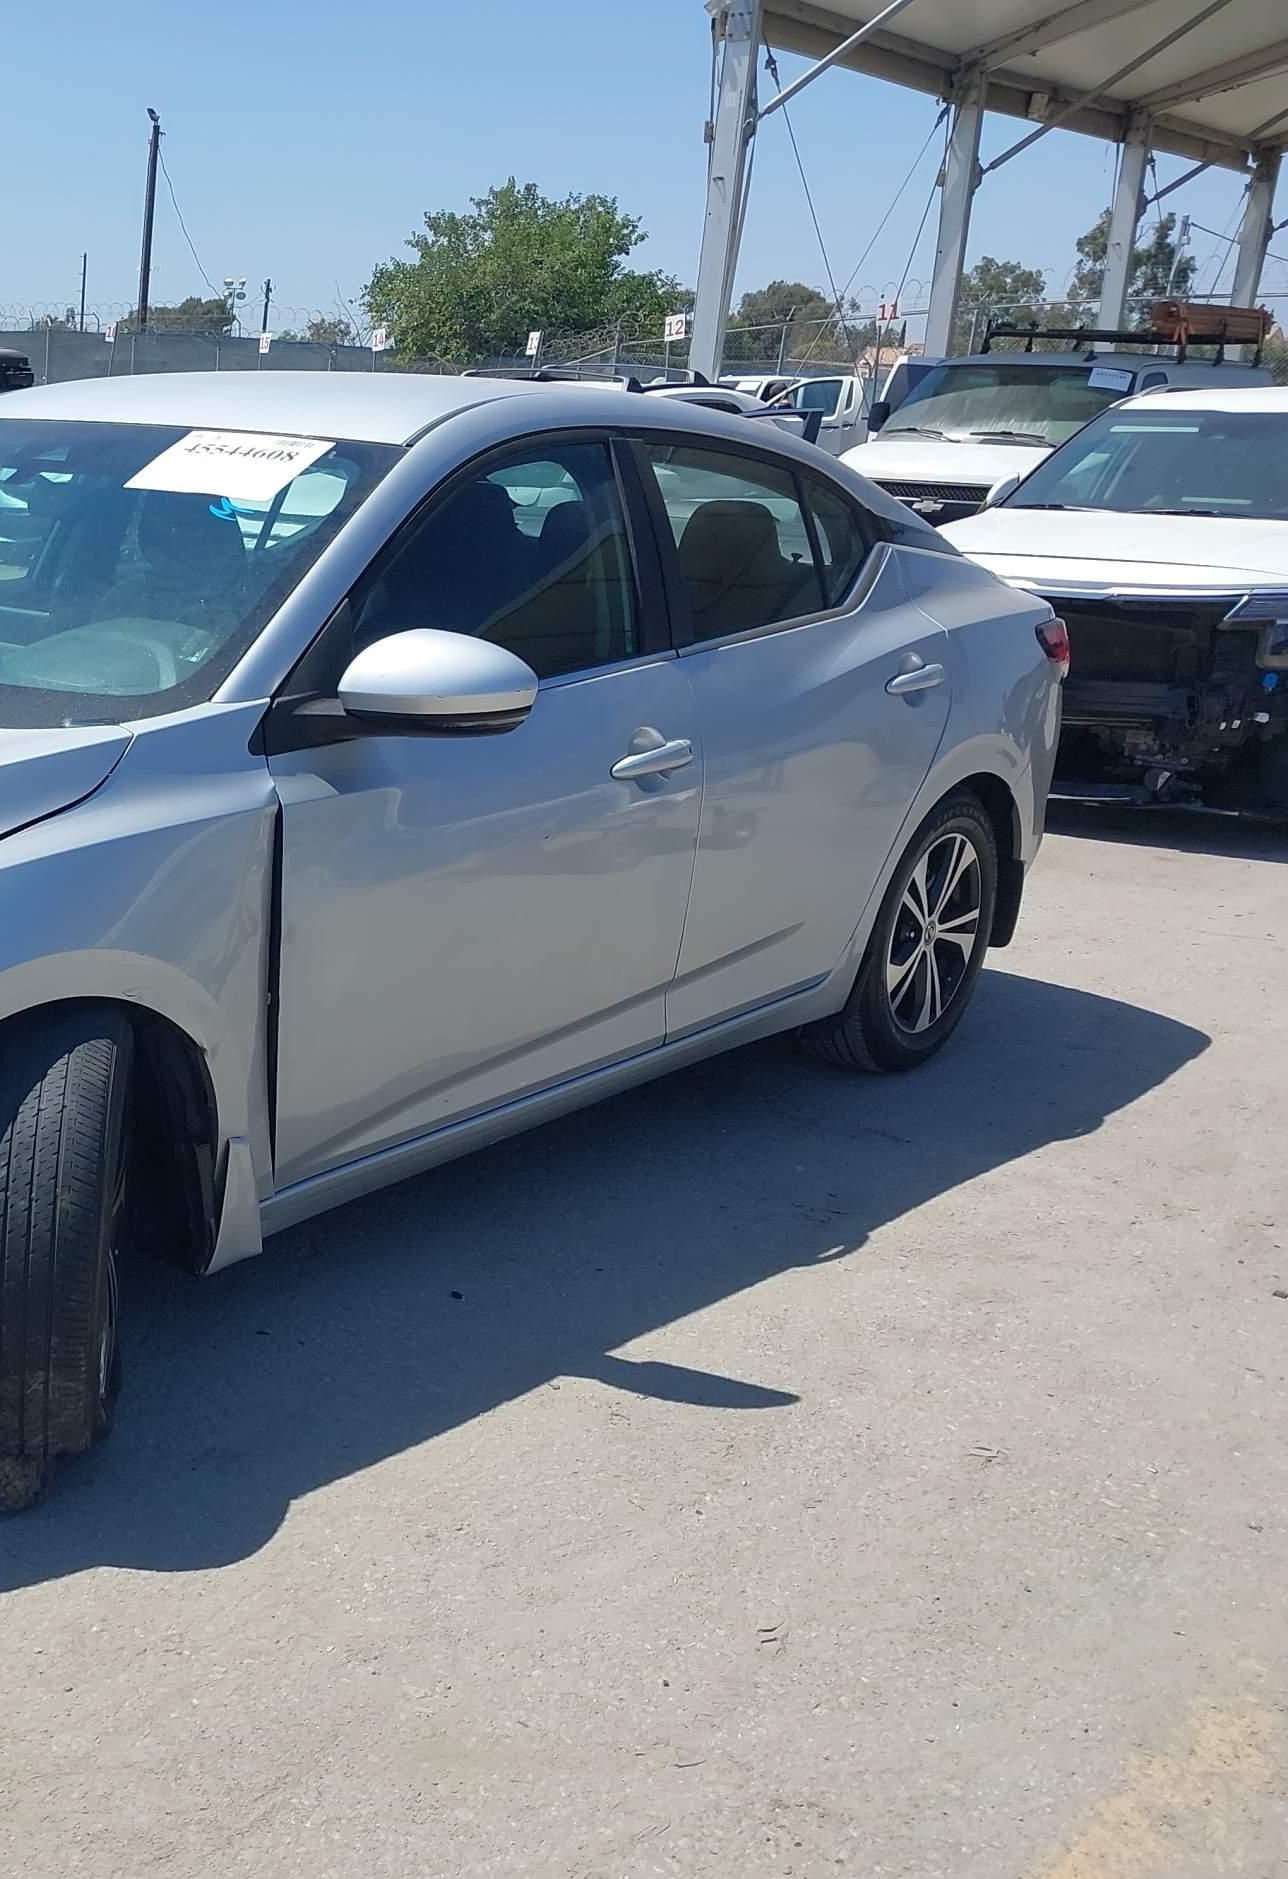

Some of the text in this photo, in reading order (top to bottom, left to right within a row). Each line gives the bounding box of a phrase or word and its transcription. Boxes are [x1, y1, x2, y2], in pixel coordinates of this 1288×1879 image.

[878, 303, 899, 321] 11
[666, 319, 684, 337] 12
[259, 336, 270, 350] 15
[373, 333, 383, 347] 14
[183, 442, 300, 462] 45544608
